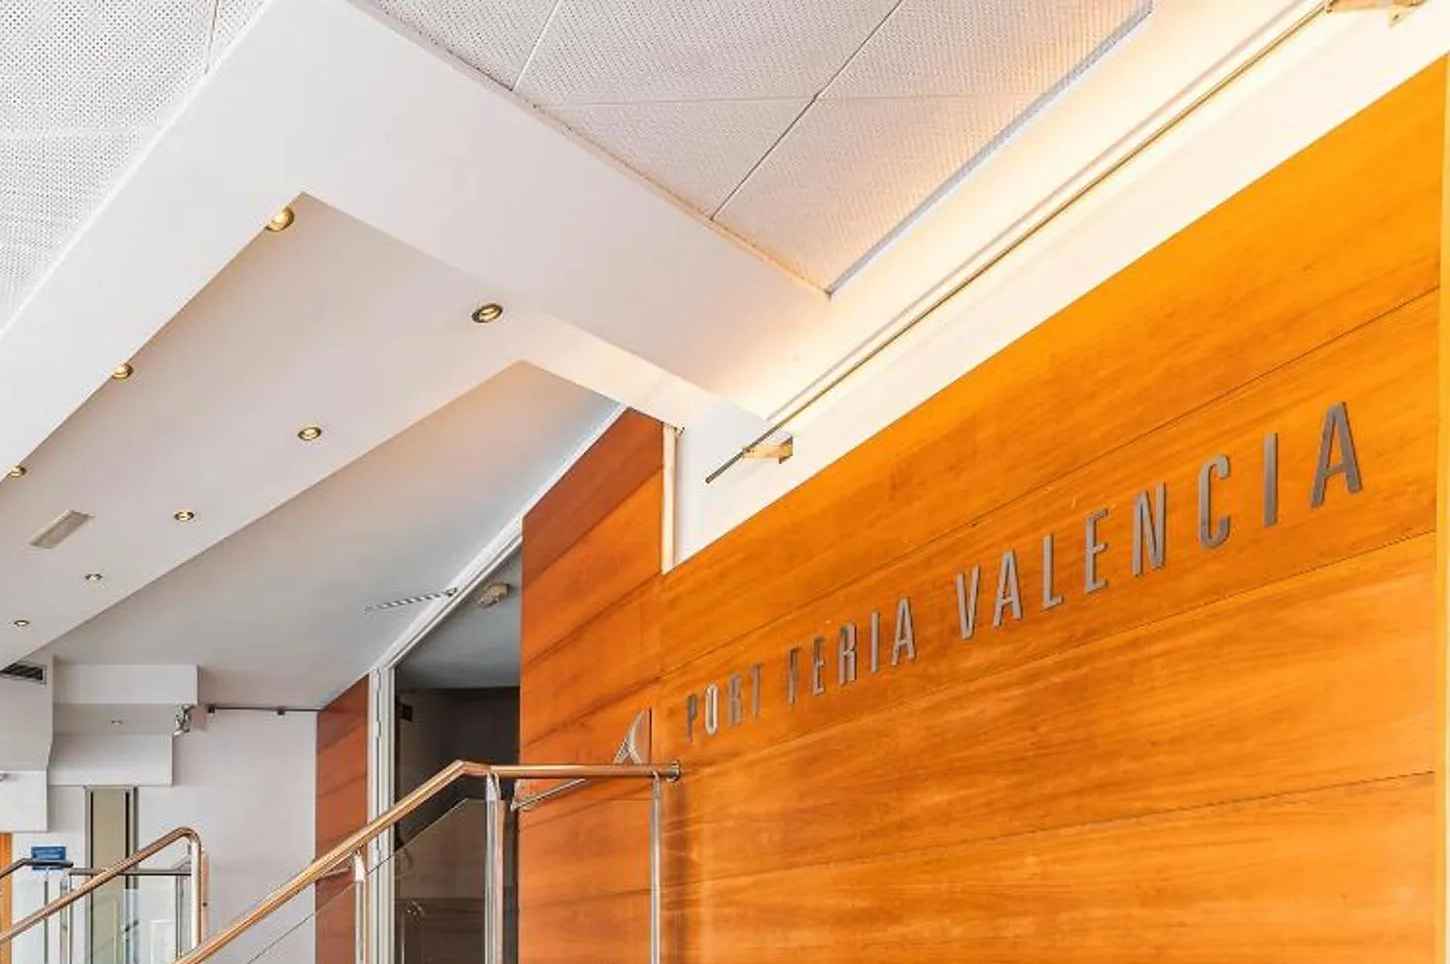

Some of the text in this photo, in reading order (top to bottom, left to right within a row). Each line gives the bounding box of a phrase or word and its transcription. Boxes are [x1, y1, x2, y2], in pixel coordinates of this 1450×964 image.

[686, 401, 1363, 741] PORT FERIA VALENCIA
